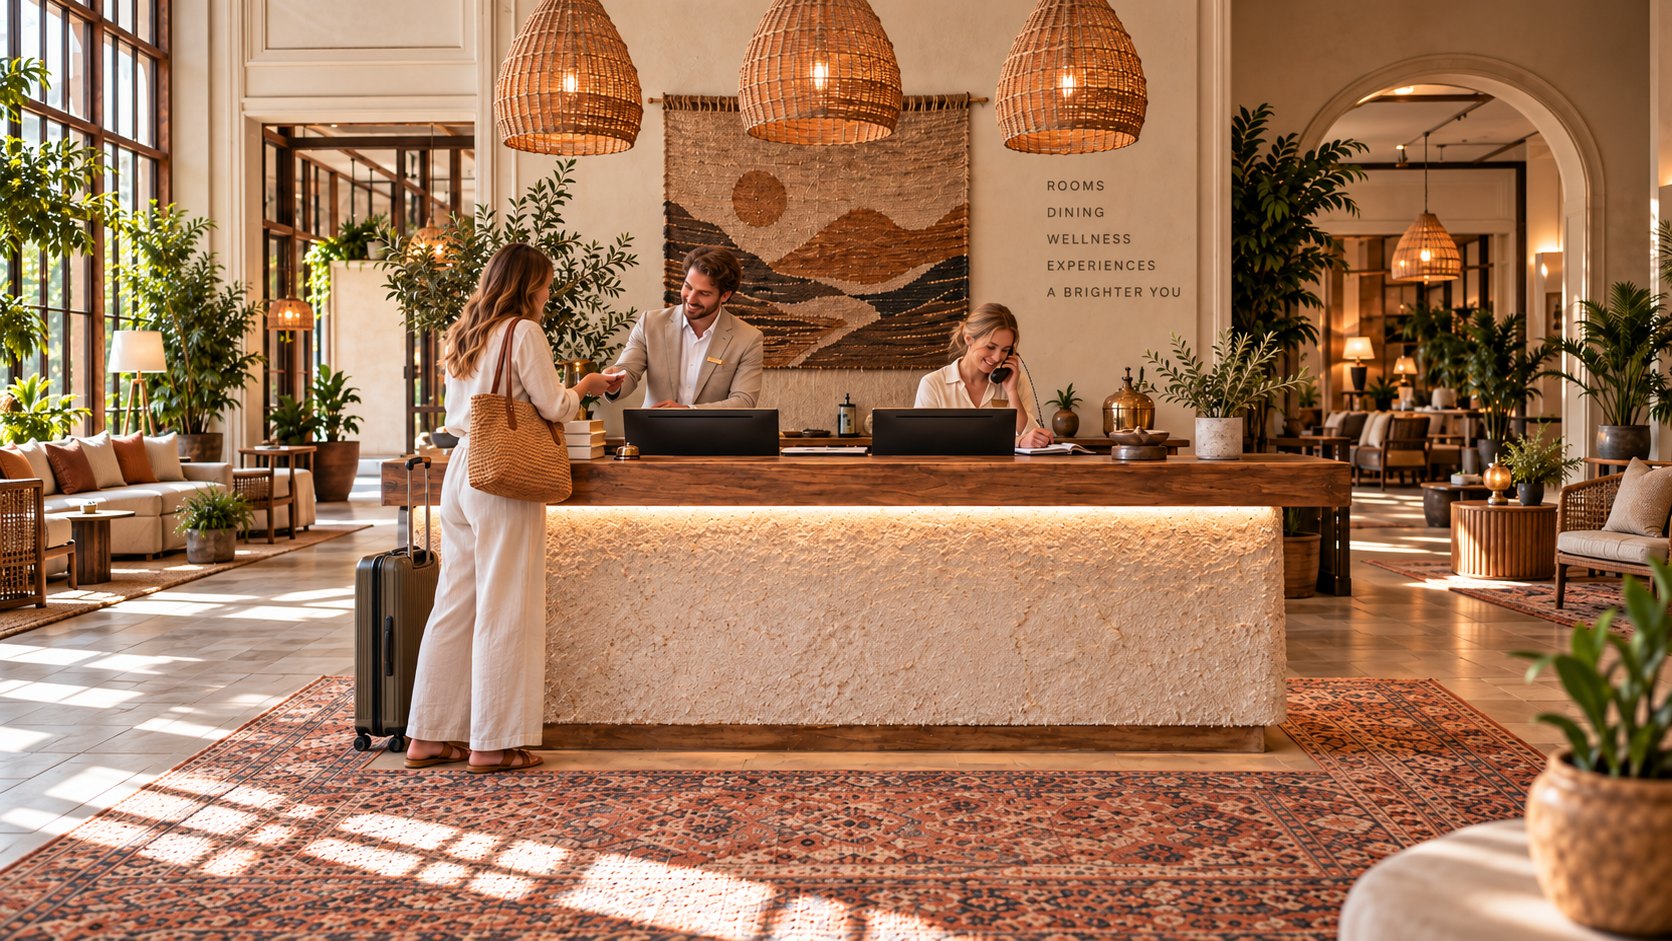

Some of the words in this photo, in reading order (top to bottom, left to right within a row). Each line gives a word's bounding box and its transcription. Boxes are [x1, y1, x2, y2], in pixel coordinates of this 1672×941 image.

[1047, 180, 1105, 191] ROOMS
[1047, 207, 1105, 218] DINING
[1047, 233, 1131, 245] WELLNESS
[1047, 260, 1156, 271] EXPERIENCES
[1047, 286, 1056, 298] A
[1063, 286, 1143, 298] BRIGHTER
[1149, 286, 1181, 298] YOU
